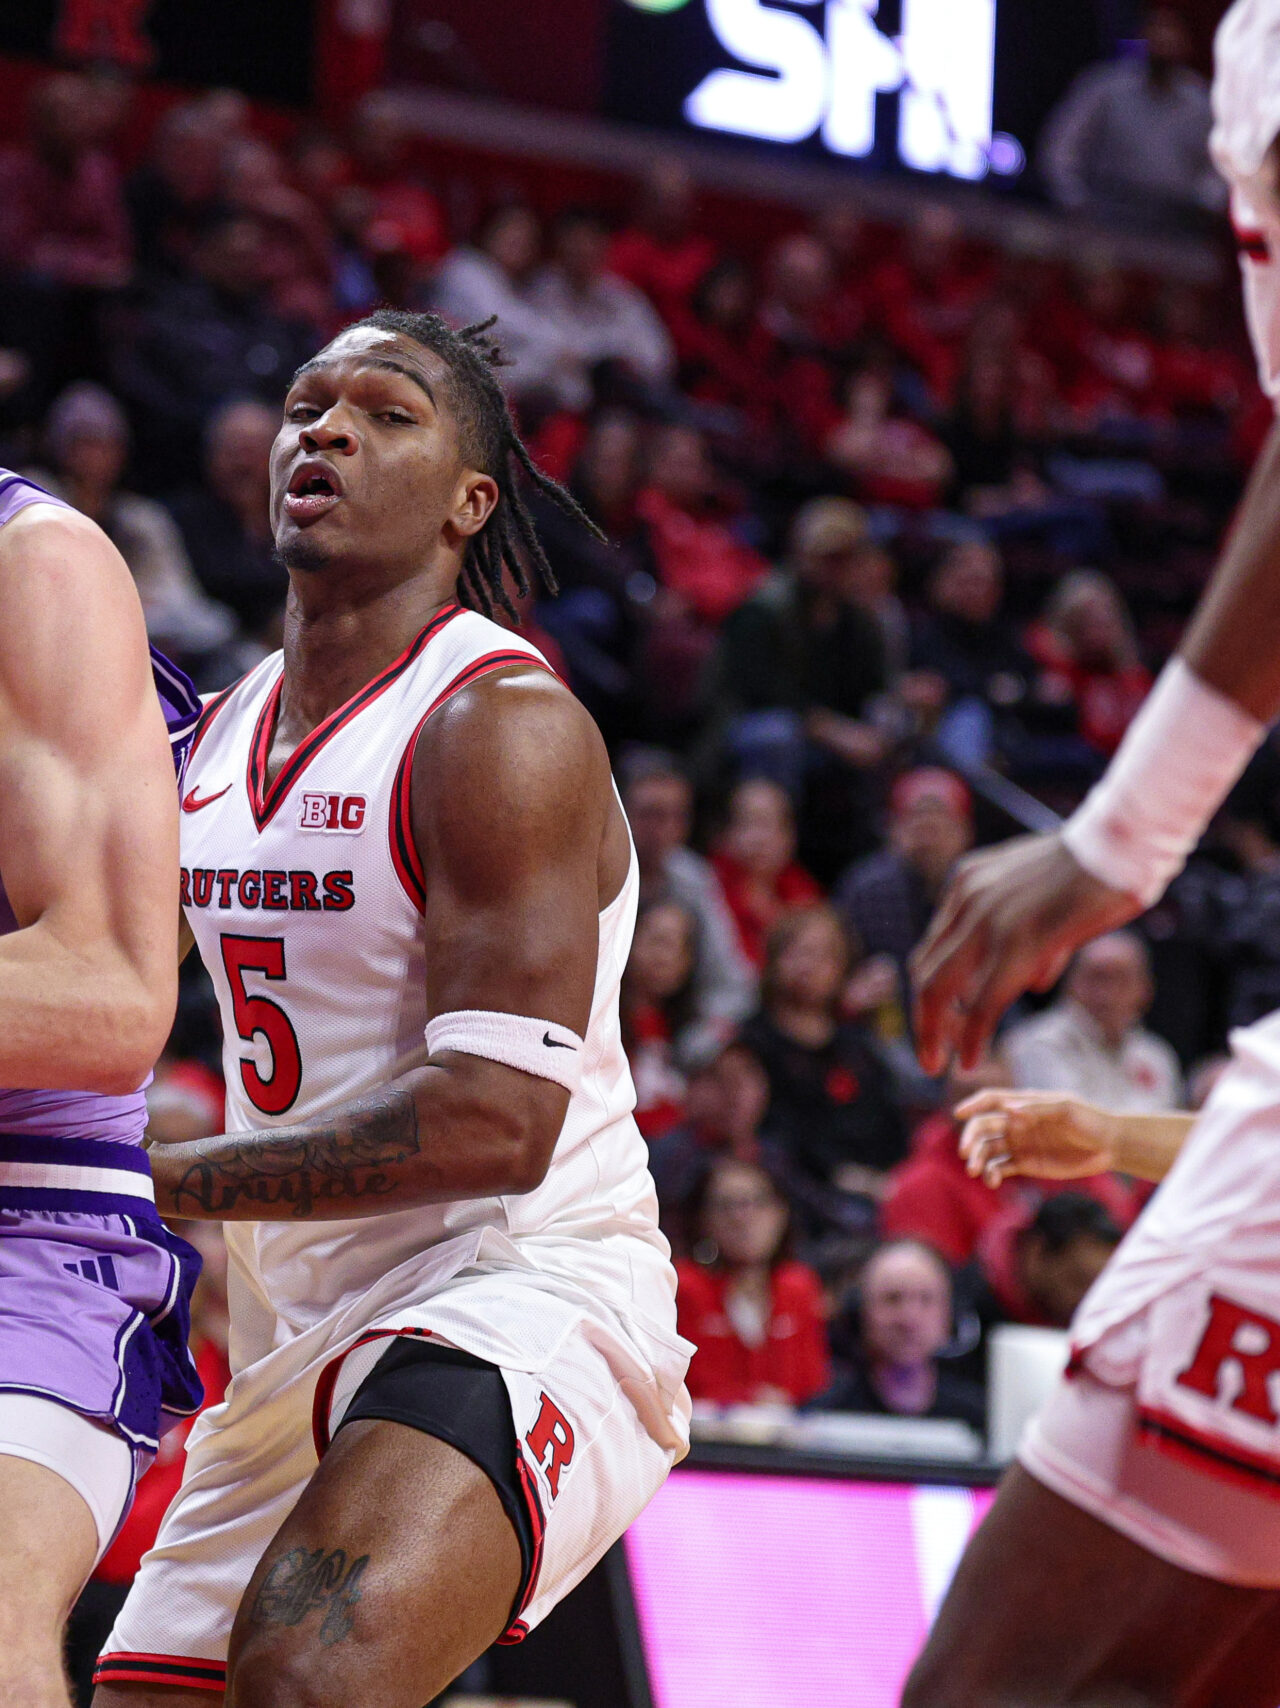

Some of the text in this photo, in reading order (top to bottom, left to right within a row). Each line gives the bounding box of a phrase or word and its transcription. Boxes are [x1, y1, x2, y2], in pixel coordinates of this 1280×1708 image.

[220, 932, 303, 1117] 5
[1175, 1291, 1280, 1426] R
[524, 1390, 575, 1501] R
